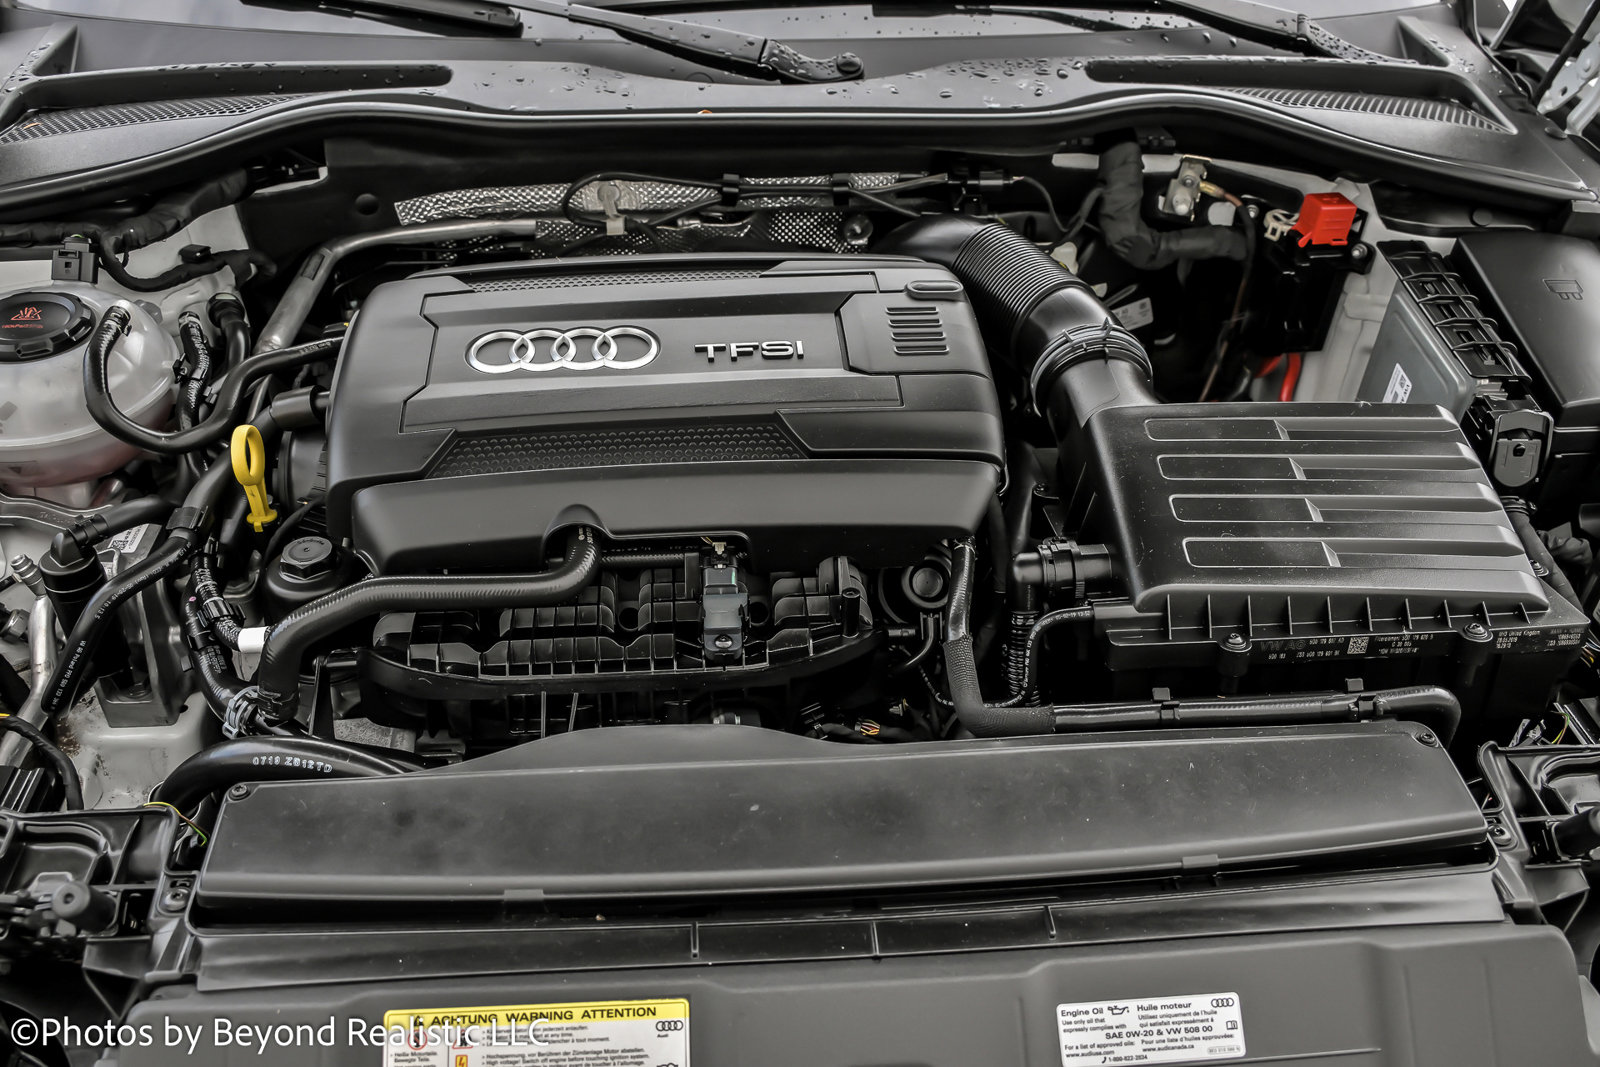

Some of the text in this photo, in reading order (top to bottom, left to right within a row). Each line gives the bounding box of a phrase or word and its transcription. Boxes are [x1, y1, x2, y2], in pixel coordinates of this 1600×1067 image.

[695, 340, 804, 362] TFSI
[1061, 1007, 1104, 1018] Engine Oil
[1137, 1002, 1192, 1012] Huile moteur
[431, 1006, 657, 1026] ACHTUNG WARNING ATTENTION
[1090, 1024, 1114, 1032] complies
[1126, 1030, 1154, 1038] 0W-20
[1166, 1027, 1182, 1035] VW
[1066, 1050, 1115, 1058] www.audiusa.com
